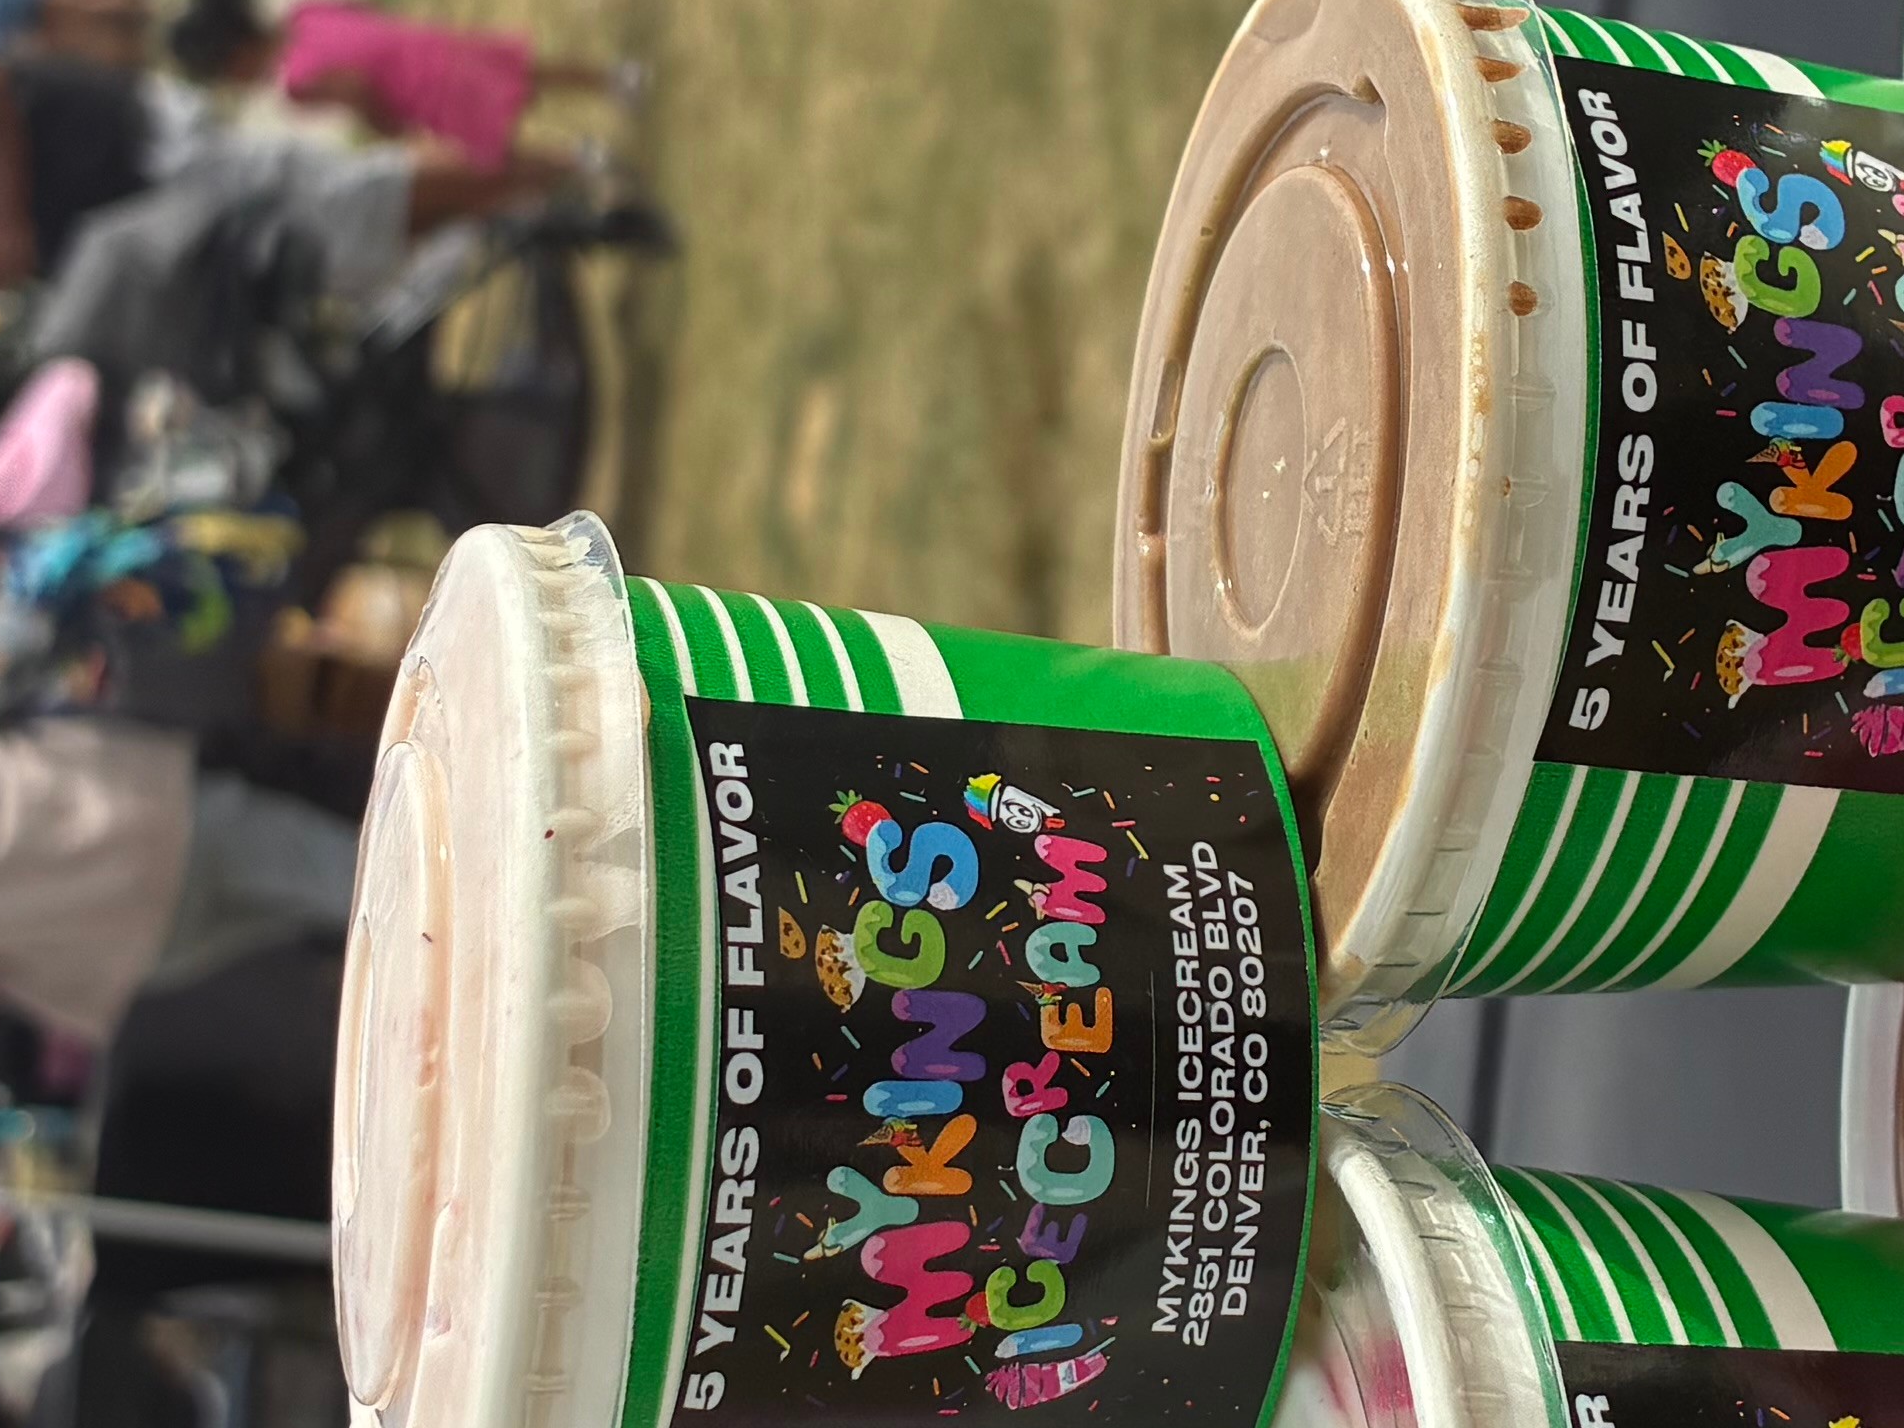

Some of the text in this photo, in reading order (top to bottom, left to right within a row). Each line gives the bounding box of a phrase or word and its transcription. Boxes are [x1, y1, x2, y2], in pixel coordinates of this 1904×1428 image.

[1568, 87, 1658, 731] 5 YEARS OF FLAVOR
[683, 742, 765, 1410] 5 YEARS OF FLAVOR
[1151, 864, 1203, 1333] MYKINGS ICECREAM
[1182, 841, 1236, 1346] 2851 COLORADO BLVD
[1220, 871, 1271, 1316] DENVER, CO 80207
